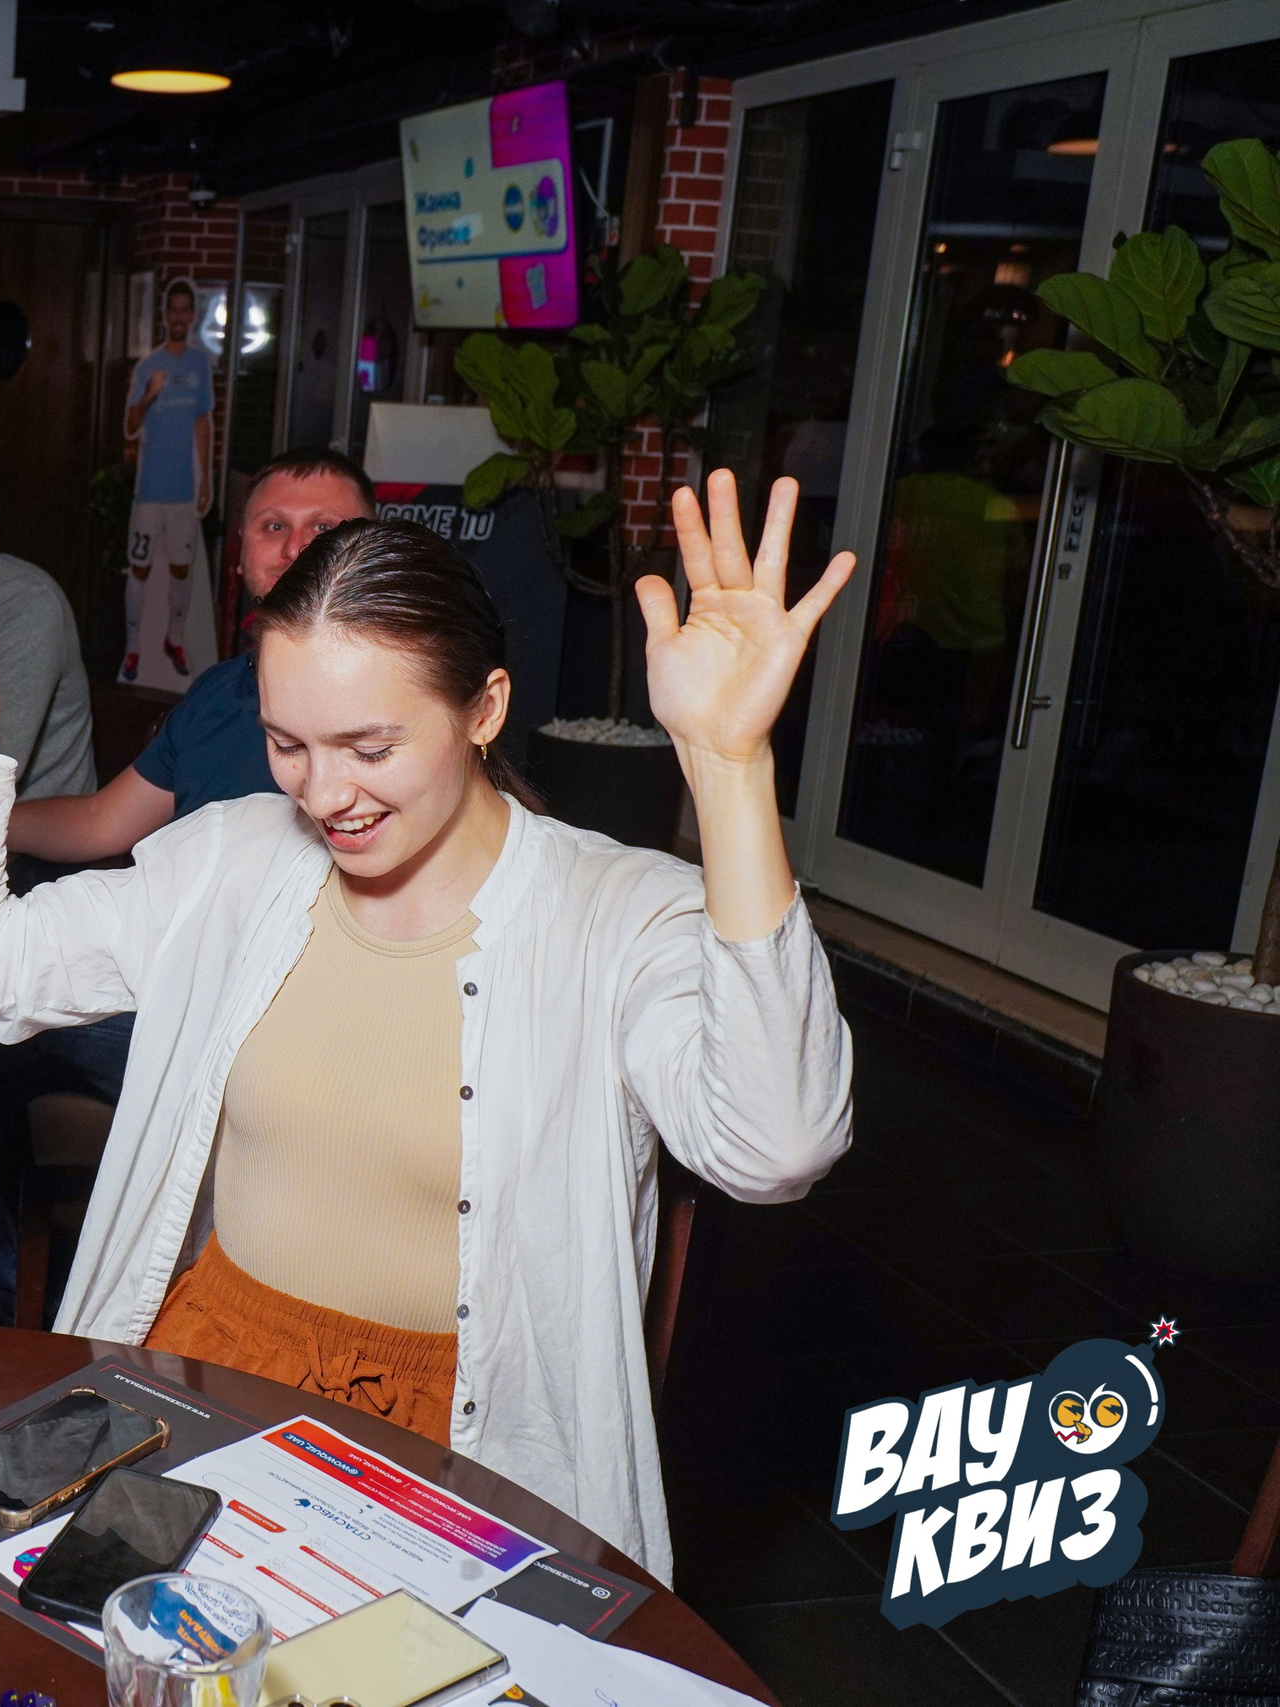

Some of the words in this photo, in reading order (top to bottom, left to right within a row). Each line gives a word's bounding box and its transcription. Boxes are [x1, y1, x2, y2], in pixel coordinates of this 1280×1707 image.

[415, 191, 461, 215] Жанна
[460, 508, 495, 541] TO
[131, 531, 151, 561] 23
[284, 1431, 359, 1476] @WOWQUIZ_UAE
[309, 1493, 337, 1511] ТОЛЬКО
[310, 1501, 371, 1542] СПАСИБО
